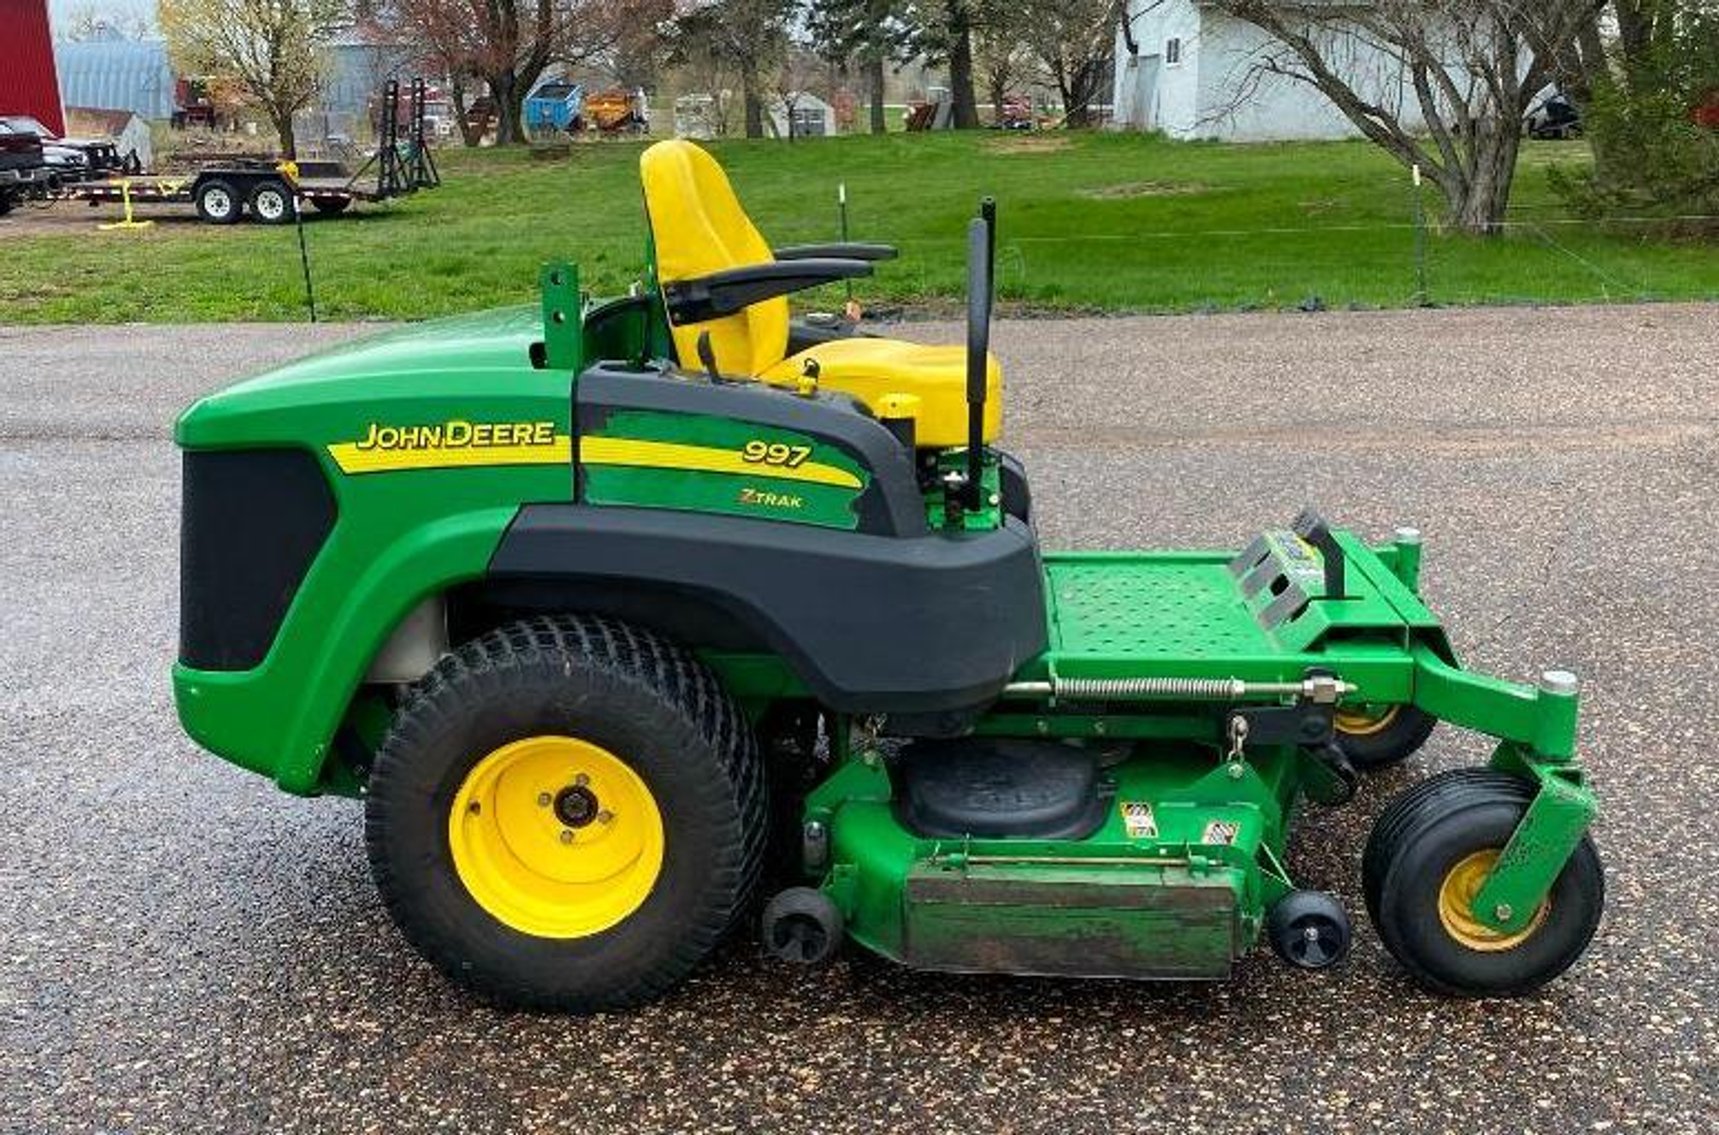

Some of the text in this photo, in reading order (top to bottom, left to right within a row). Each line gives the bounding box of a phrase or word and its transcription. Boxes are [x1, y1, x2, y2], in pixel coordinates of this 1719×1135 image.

[357, 420, 555, 450] JOHN DEERE
[743, 440, 813, 468] 997
